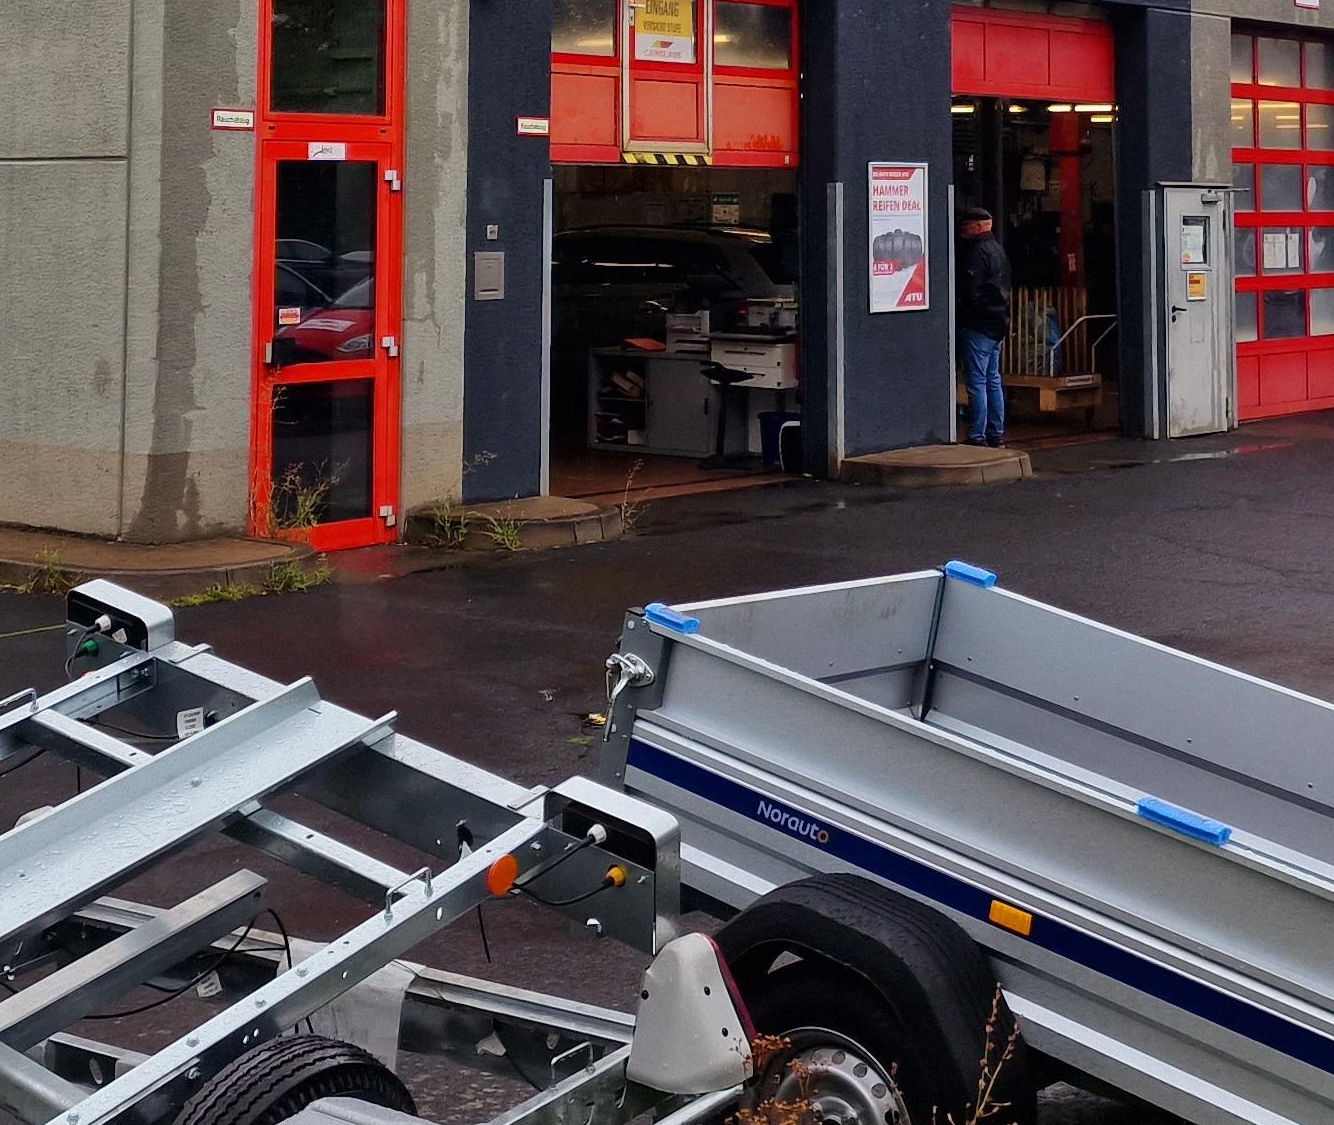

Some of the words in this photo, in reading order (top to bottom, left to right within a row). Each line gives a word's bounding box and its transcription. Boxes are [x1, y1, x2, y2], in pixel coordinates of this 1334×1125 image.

[646, 0, 679, 17] EINGANG
[873, 185, 908, 195] HAMMER
[757, 801, 829, 843] Norauto
